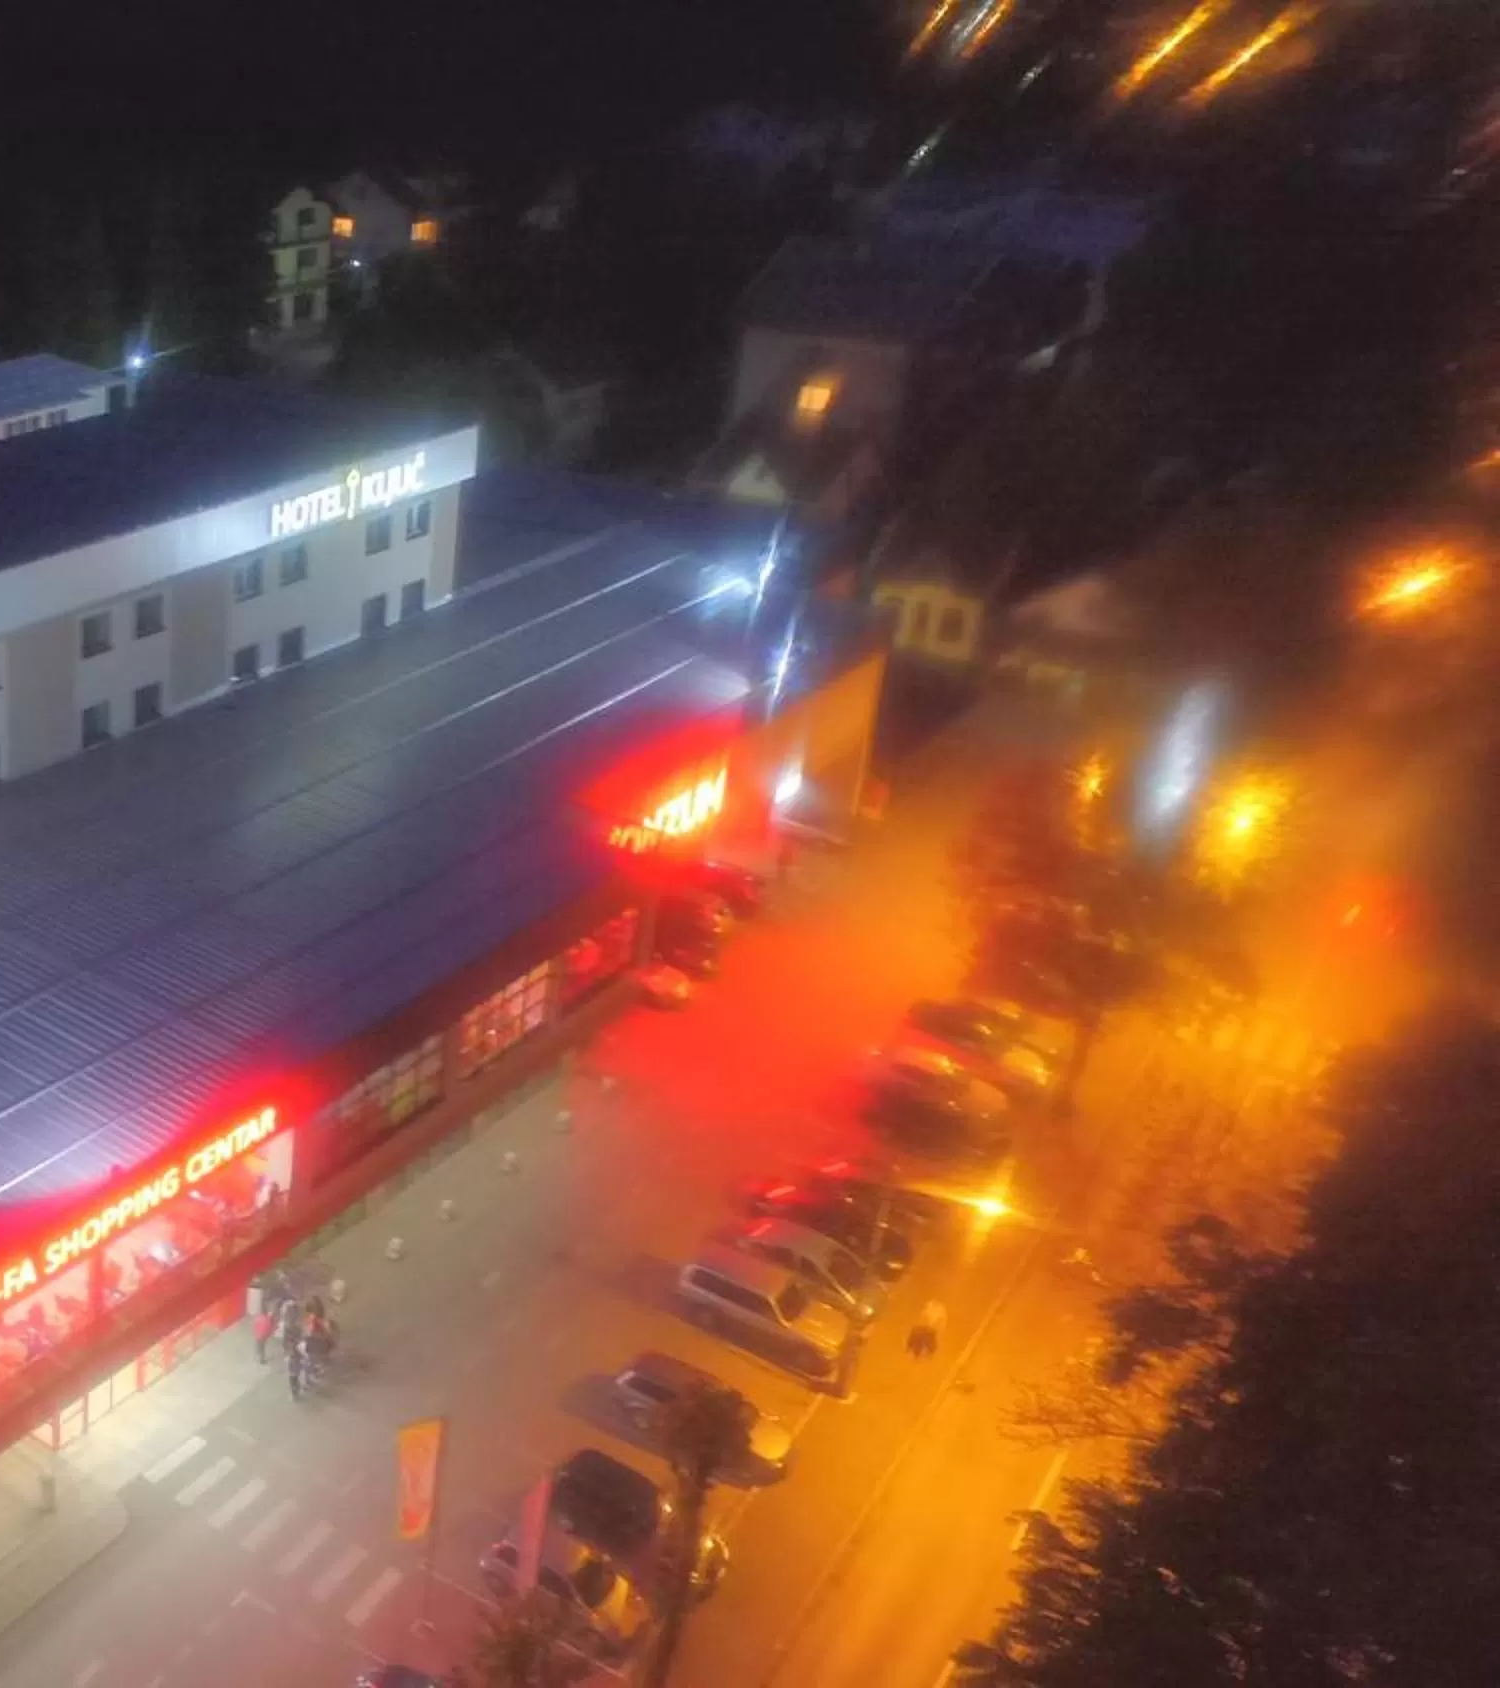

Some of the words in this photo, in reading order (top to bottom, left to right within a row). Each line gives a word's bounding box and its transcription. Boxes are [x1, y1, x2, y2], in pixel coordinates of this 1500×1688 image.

[271, 485, 346, 538] HOTEL
[44, 1167, 181, 1274] SHOPPING
[185, 1107, 276, 1183] CENTAR
